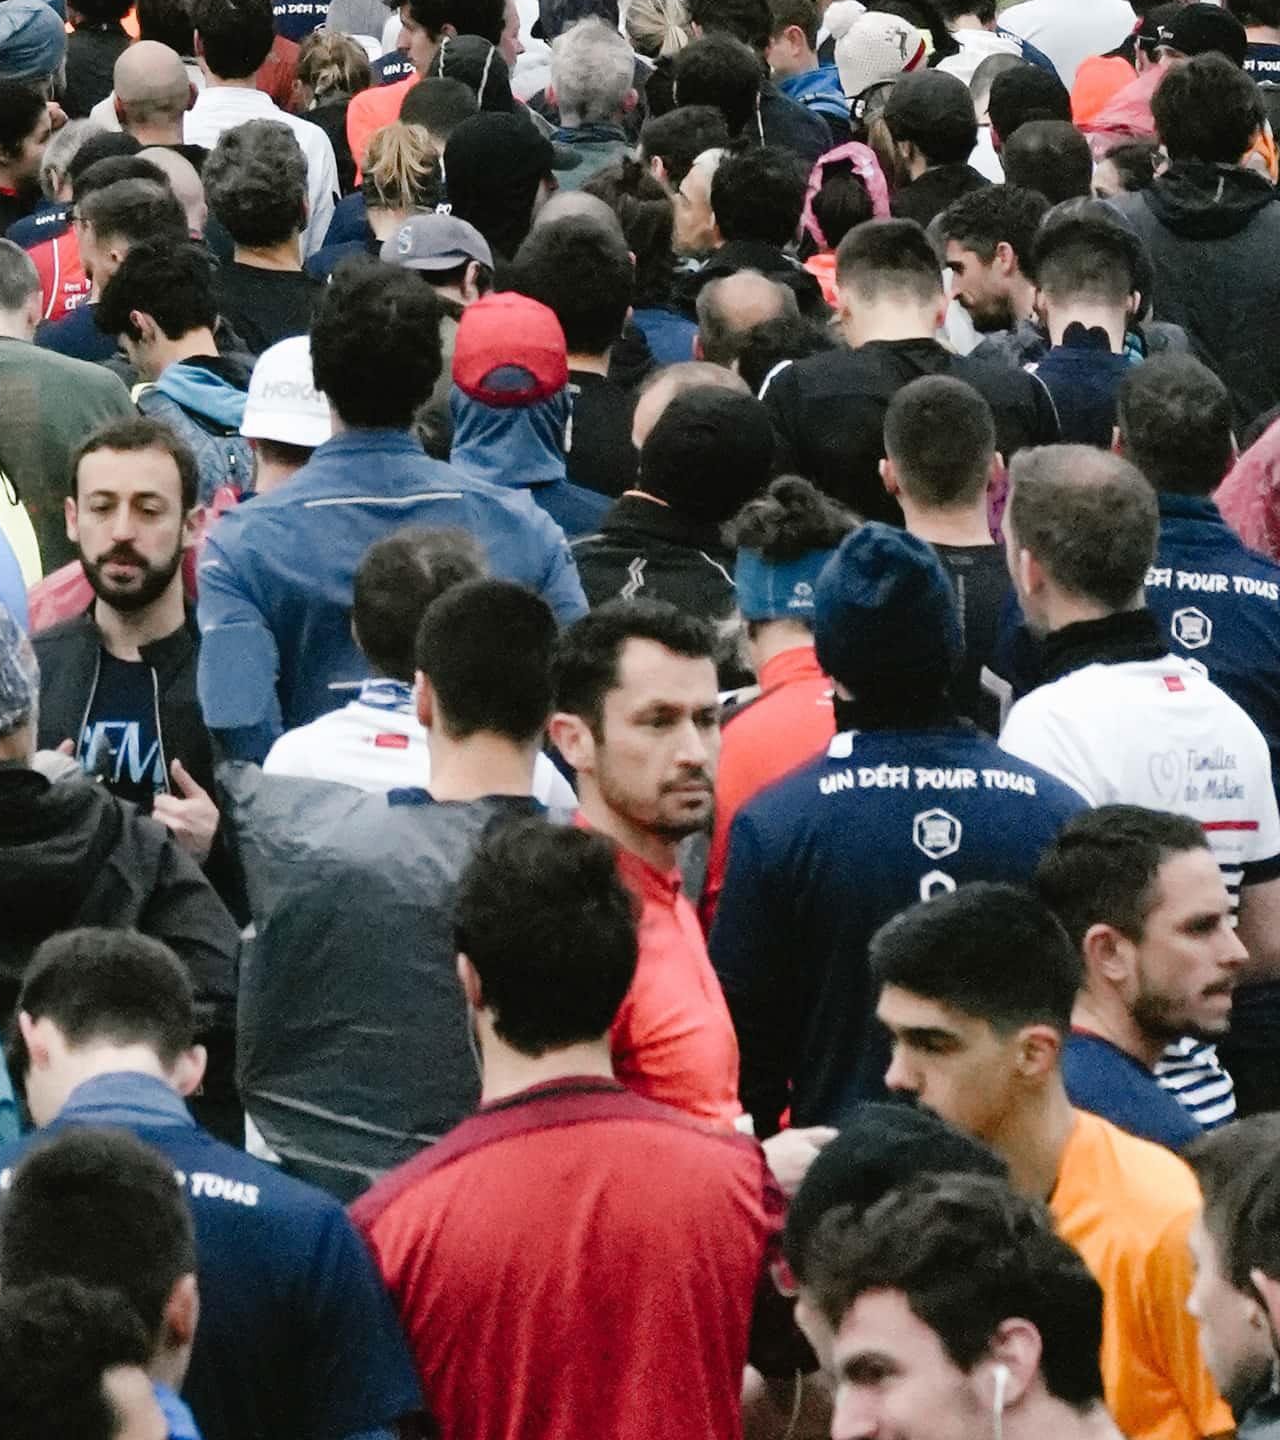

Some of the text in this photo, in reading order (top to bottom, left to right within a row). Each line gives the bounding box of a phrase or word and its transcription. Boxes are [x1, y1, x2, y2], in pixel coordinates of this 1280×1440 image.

[287, 3, 313, 14] DÉFI
[314, 4, 330, 15] PO
[1257, 60, 1280, 71] POU
[1176, 570, 1229, 592] POUR
[1231, 575, 1280, 601] TOUS
[819, 762, 1037, 797] UN DÉFI POUR TOUS
[191, 1173, 260, 1207] TOUS
